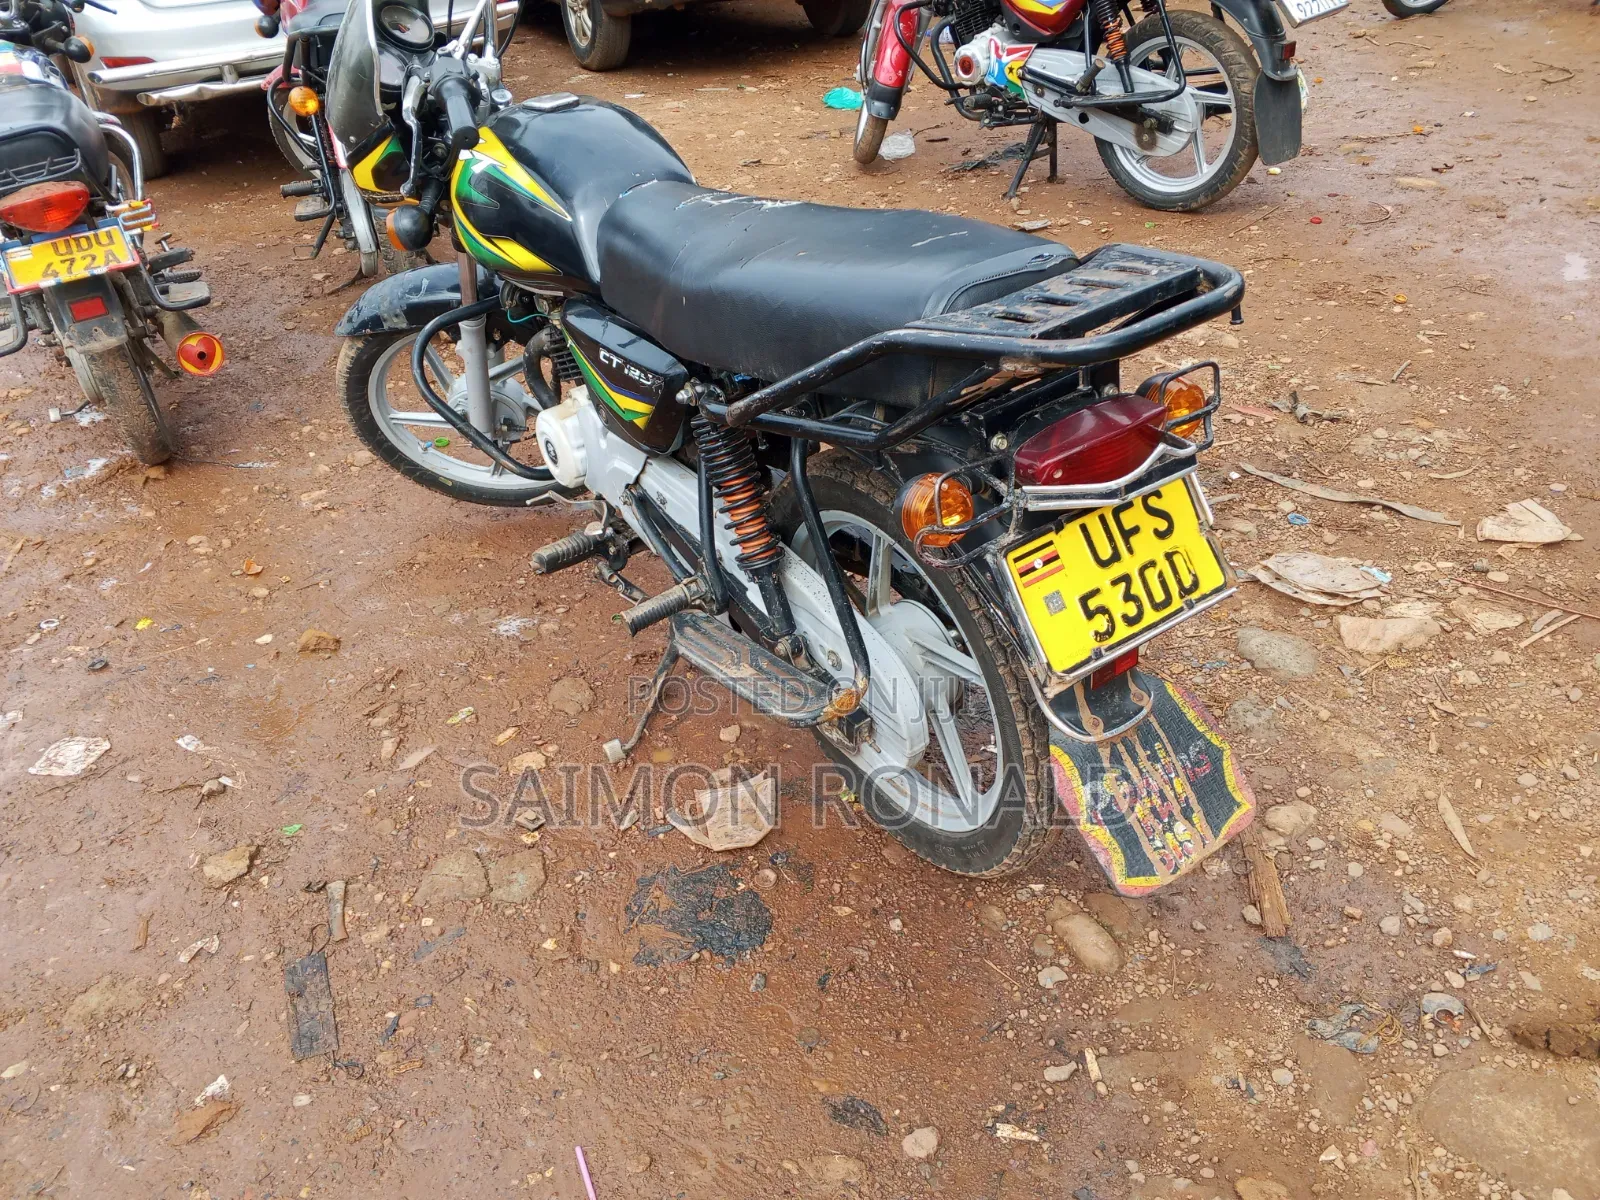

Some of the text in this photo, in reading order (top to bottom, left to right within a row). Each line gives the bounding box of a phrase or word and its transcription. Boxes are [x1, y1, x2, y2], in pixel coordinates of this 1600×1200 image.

[51, 230, 116, 257] UDU
[42, 249, 121, 279] 472A
[1080, 489, 1175, 570] UFS
